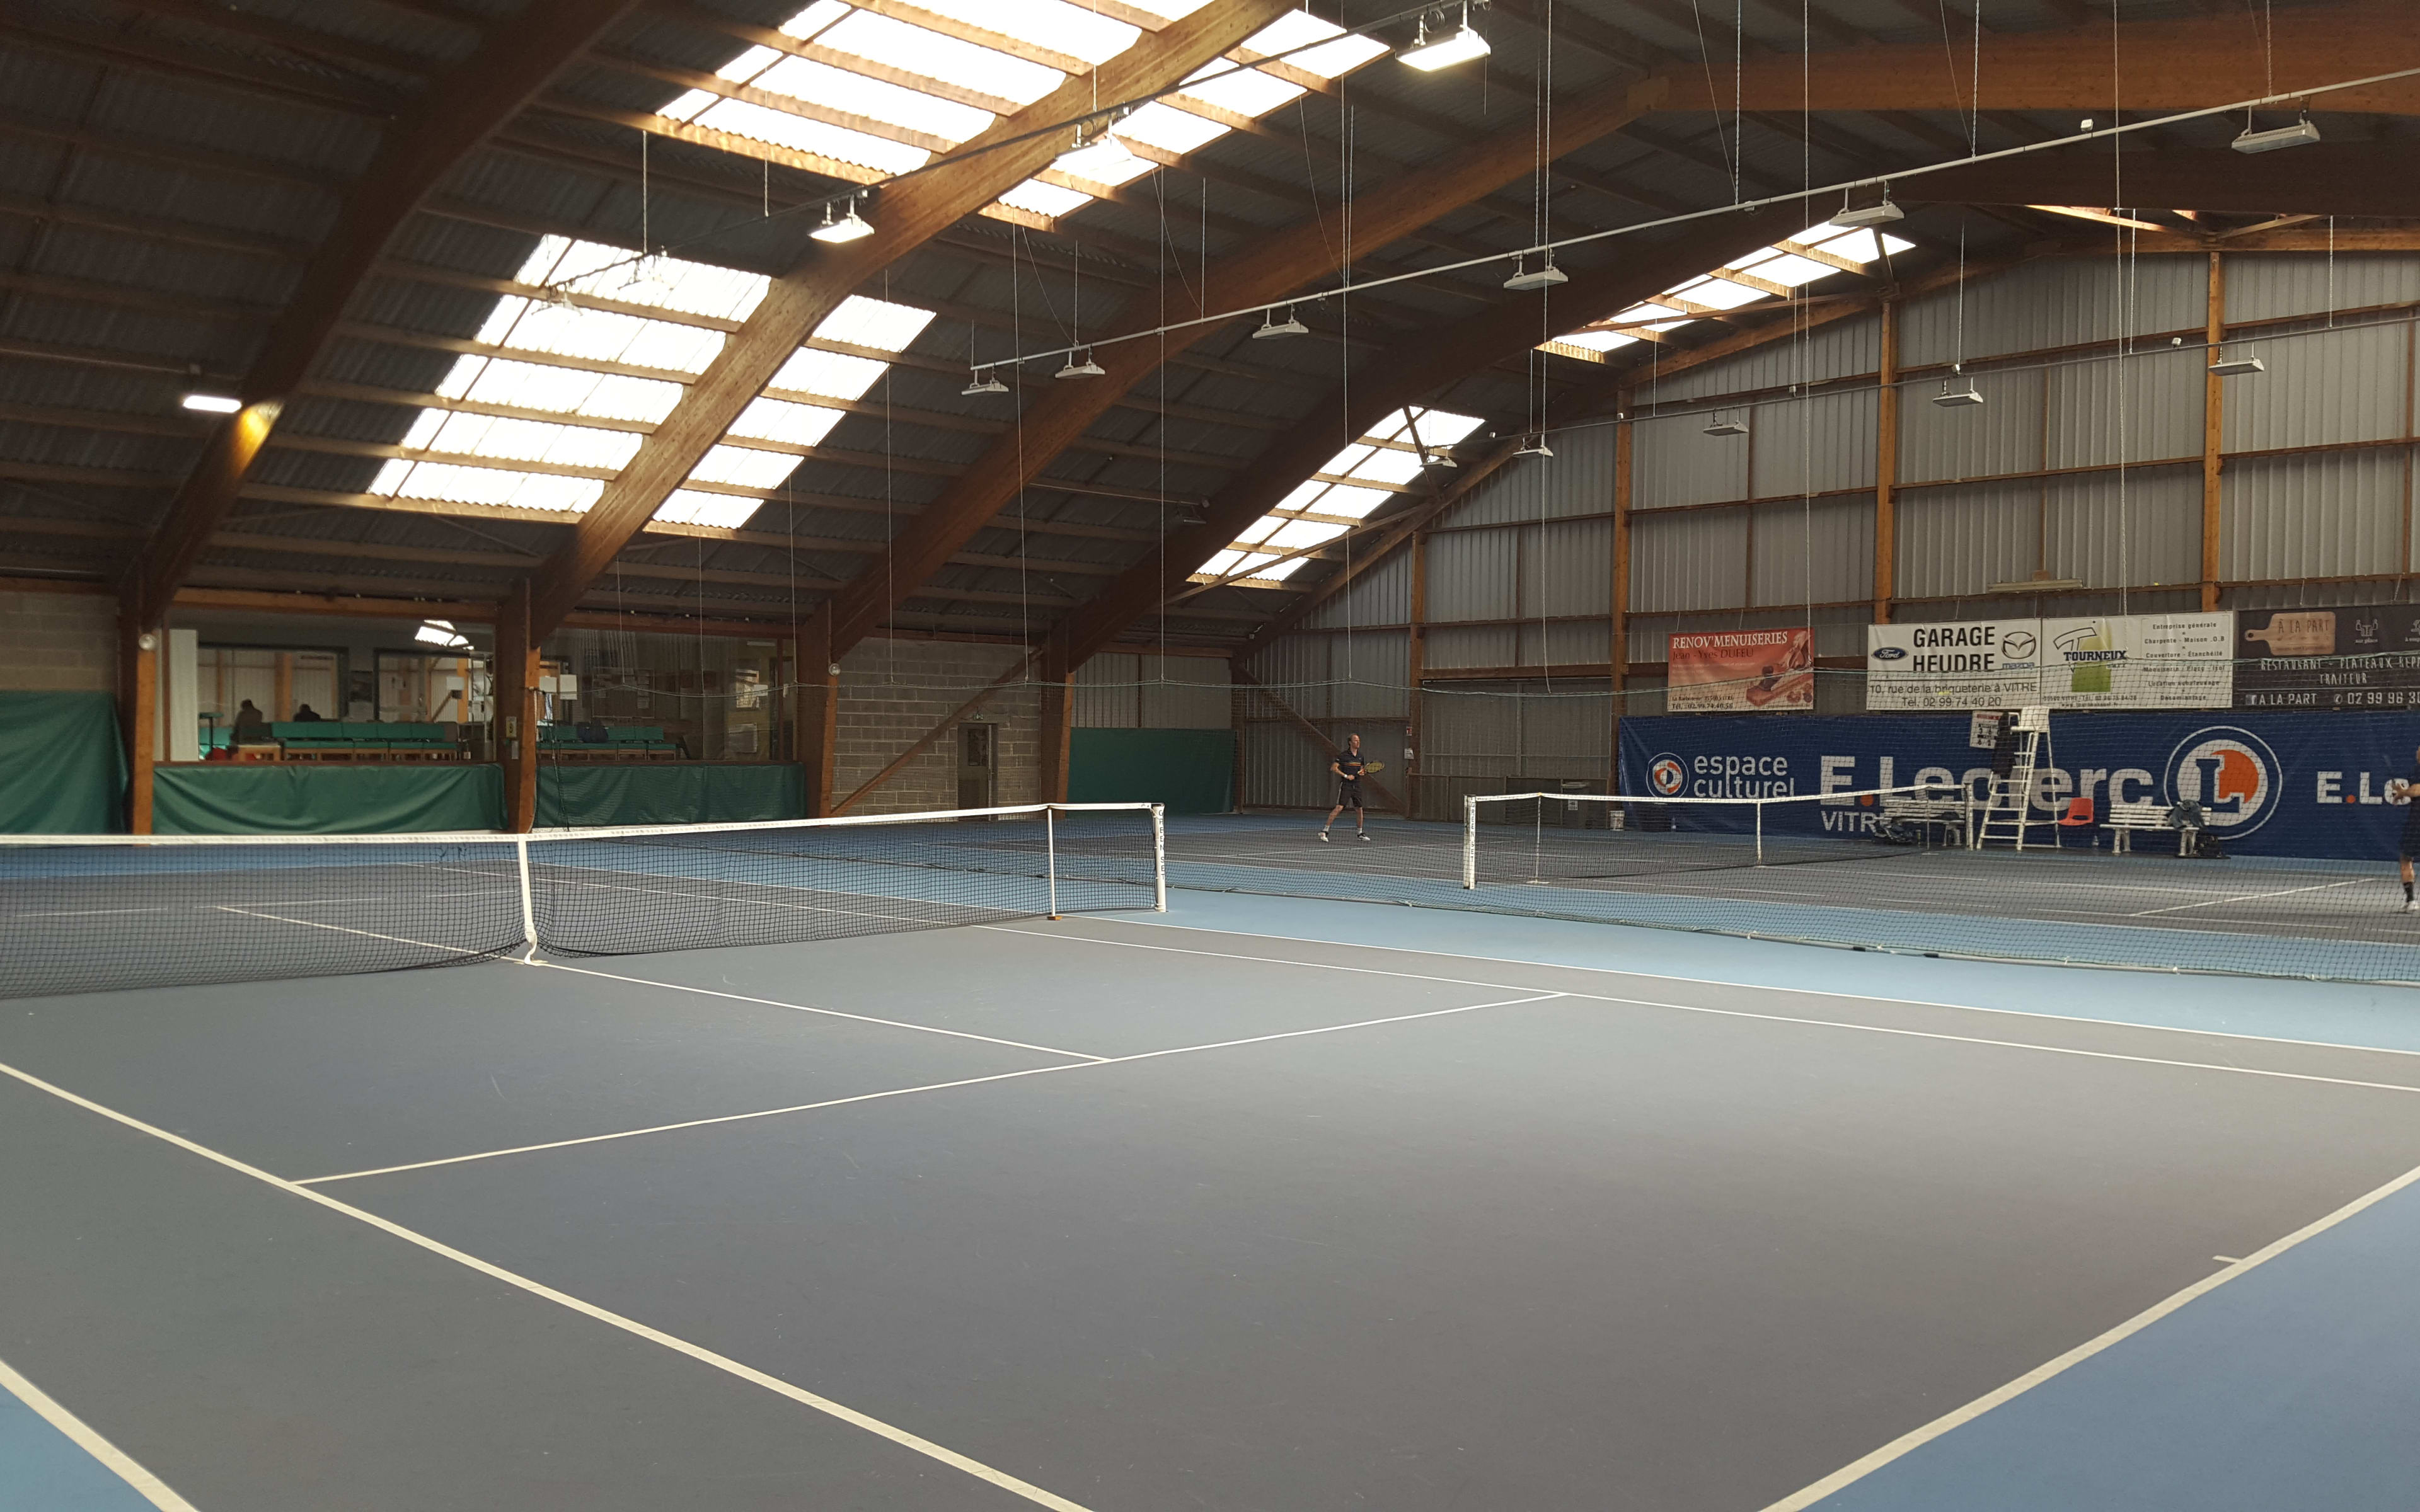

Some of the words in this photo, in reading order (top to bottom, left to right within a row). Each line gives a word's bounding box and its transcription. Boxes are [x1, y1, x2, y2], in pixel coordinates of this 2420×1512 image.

[2290, 620, 2300, 633] LA
[2307, 619, 2329, 633] PART
[1673, 631, 1788, 649] RENOV'MENUISERIES
[1913, 626, 1995, 648] GARAGE
[1673, 651, 1690, 660] Jean
[1698, 650, 1717, 659] Yves
[2063, 650, 2127, 662] TOURNEUX
[1913, 653, 1995, 673] HEUDRE
[2261, 659, 2321, 670] RESTAURANT
[2340, 657, 2393, 669] PLATEAUX
[2319, 673, 2367, 685] TRAITEUR
[1906, 684, 1920, 693] de
[1923, 684, 1931, 693] la
[1935, 684, 1991, 695] briqueterie
[1923, 697, 1935, 707] 02
[1939, 697, 1952, 707] 99
[1956, 697, 1968, 706] 74
[1971, 697, 1985, 706] 40
[1988, 697, 2002, 706] 20
[2271, 694, 2283, 705] LA
[2288, 693, 2317, 705] PART
[2348, 693, 2363, 704] 02
[2367, 692, 2382, 704] 99
[2388, 692, 2403, 704] 96
[1694, 755, 1789, 781] espace
[1693, 777, 1795, 798] culturel
[1821, 811, 1884, 832] VITR
